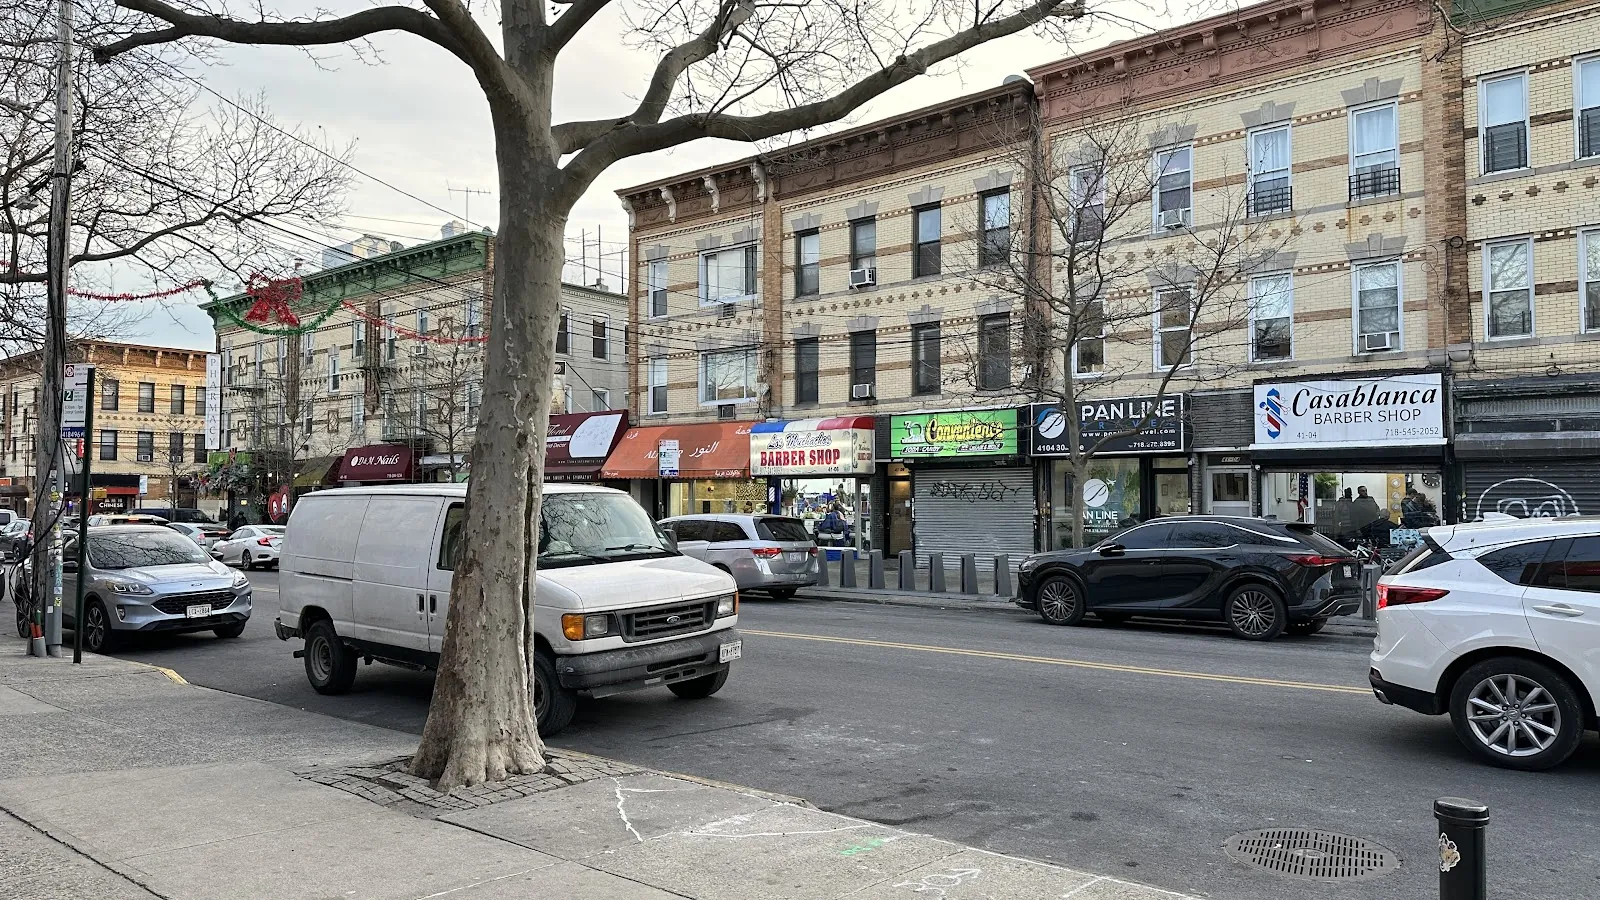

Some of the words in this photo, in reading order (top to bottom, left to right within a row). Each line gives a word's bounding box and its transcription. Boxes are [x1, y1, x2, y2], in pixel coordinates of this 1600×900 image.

[65, 391, 71, 401] 2
[209, 358, 218, 446] PHARMACY
[1292, 384, 1437, 417] Casablanca
[1081, 402, 1124, 421] PAN
[1128, 399, 1175, 419] LINE
[1314, 411, 1373, 425] BARBER
[1377, 408, 1422, 422] SHOP
[786, 431, 833, 449] Muchachos
[925, 418, 1004, 444] Convenience
[1385, 427, 1440, 438] 718-545-2052
[688, 440, 720, 458] النور
[1036, 444, 1055, 452] 4104
[374, 453, 400, 466] Nails
[760, 450, 806, 467] BARBER
[809, 448, 841, 466] SHOP
[1082, 510, 1094, 520] AN
[1095, 510, 1119, 520] LINE
